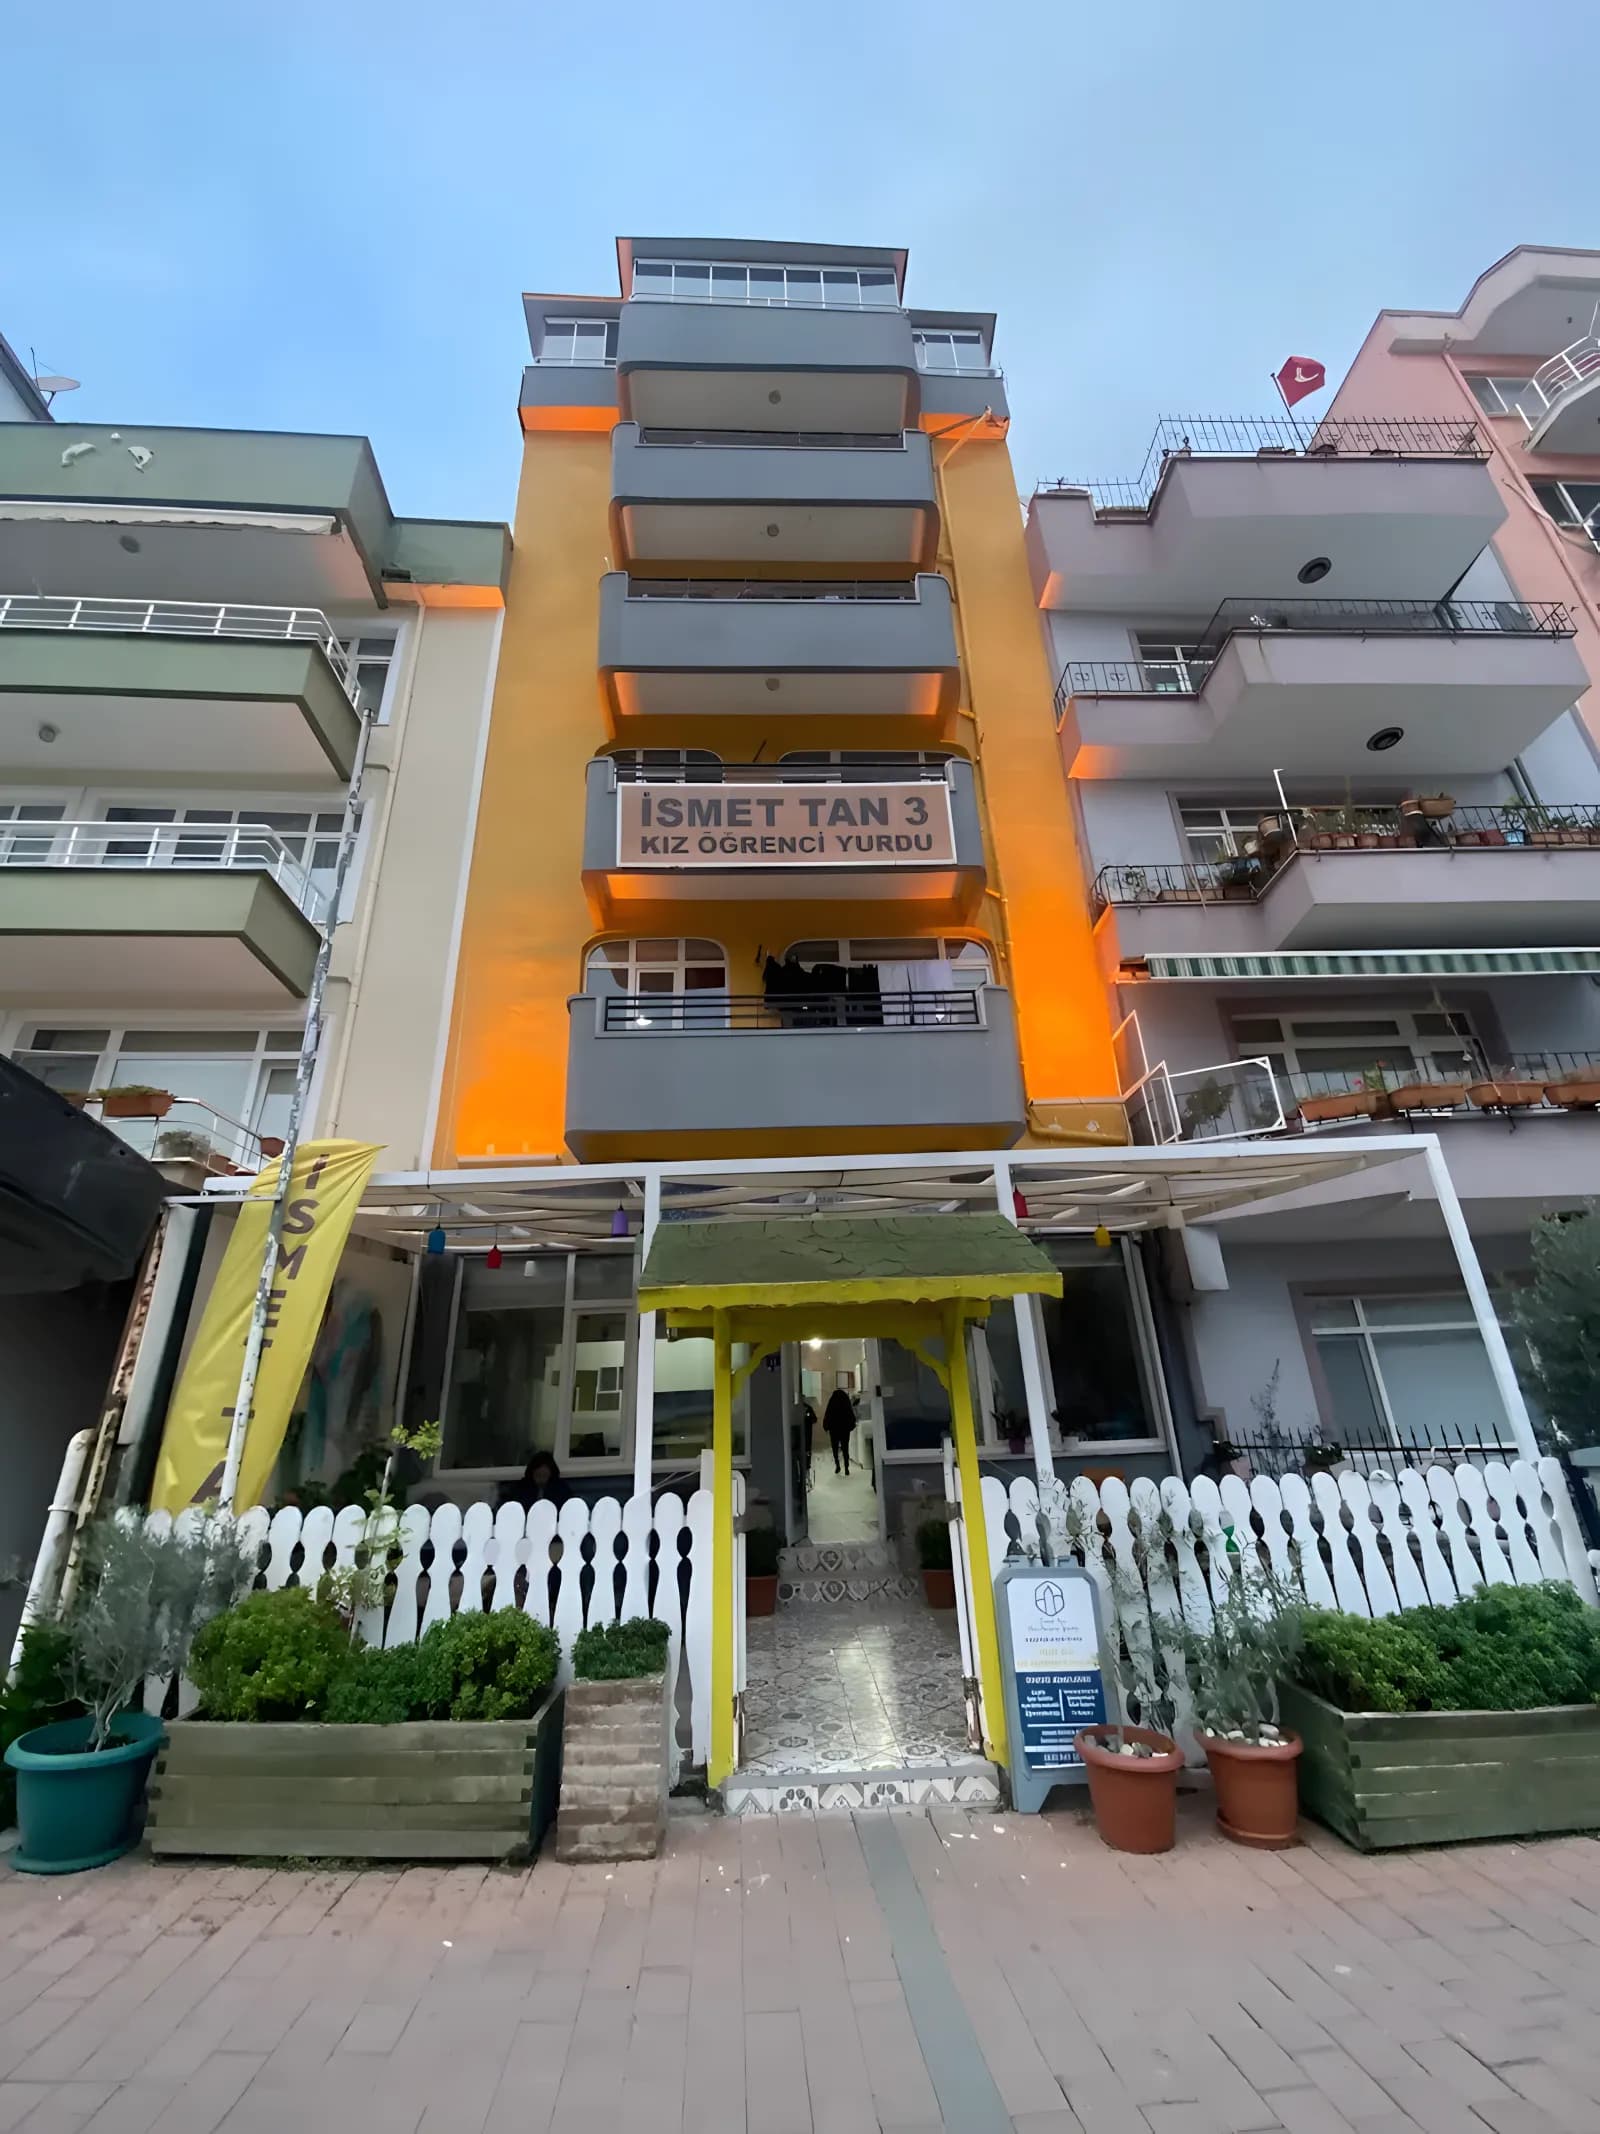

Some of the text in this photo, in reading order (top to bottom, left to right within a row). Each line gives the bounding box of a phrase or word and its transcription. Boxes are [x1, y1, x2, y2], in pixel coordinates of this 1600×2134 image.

[641, 791, 929, 828] İSMET TAN 3
[641, 836, 689, 854] KIZ
[836, 834, 933, 852] YURDU
